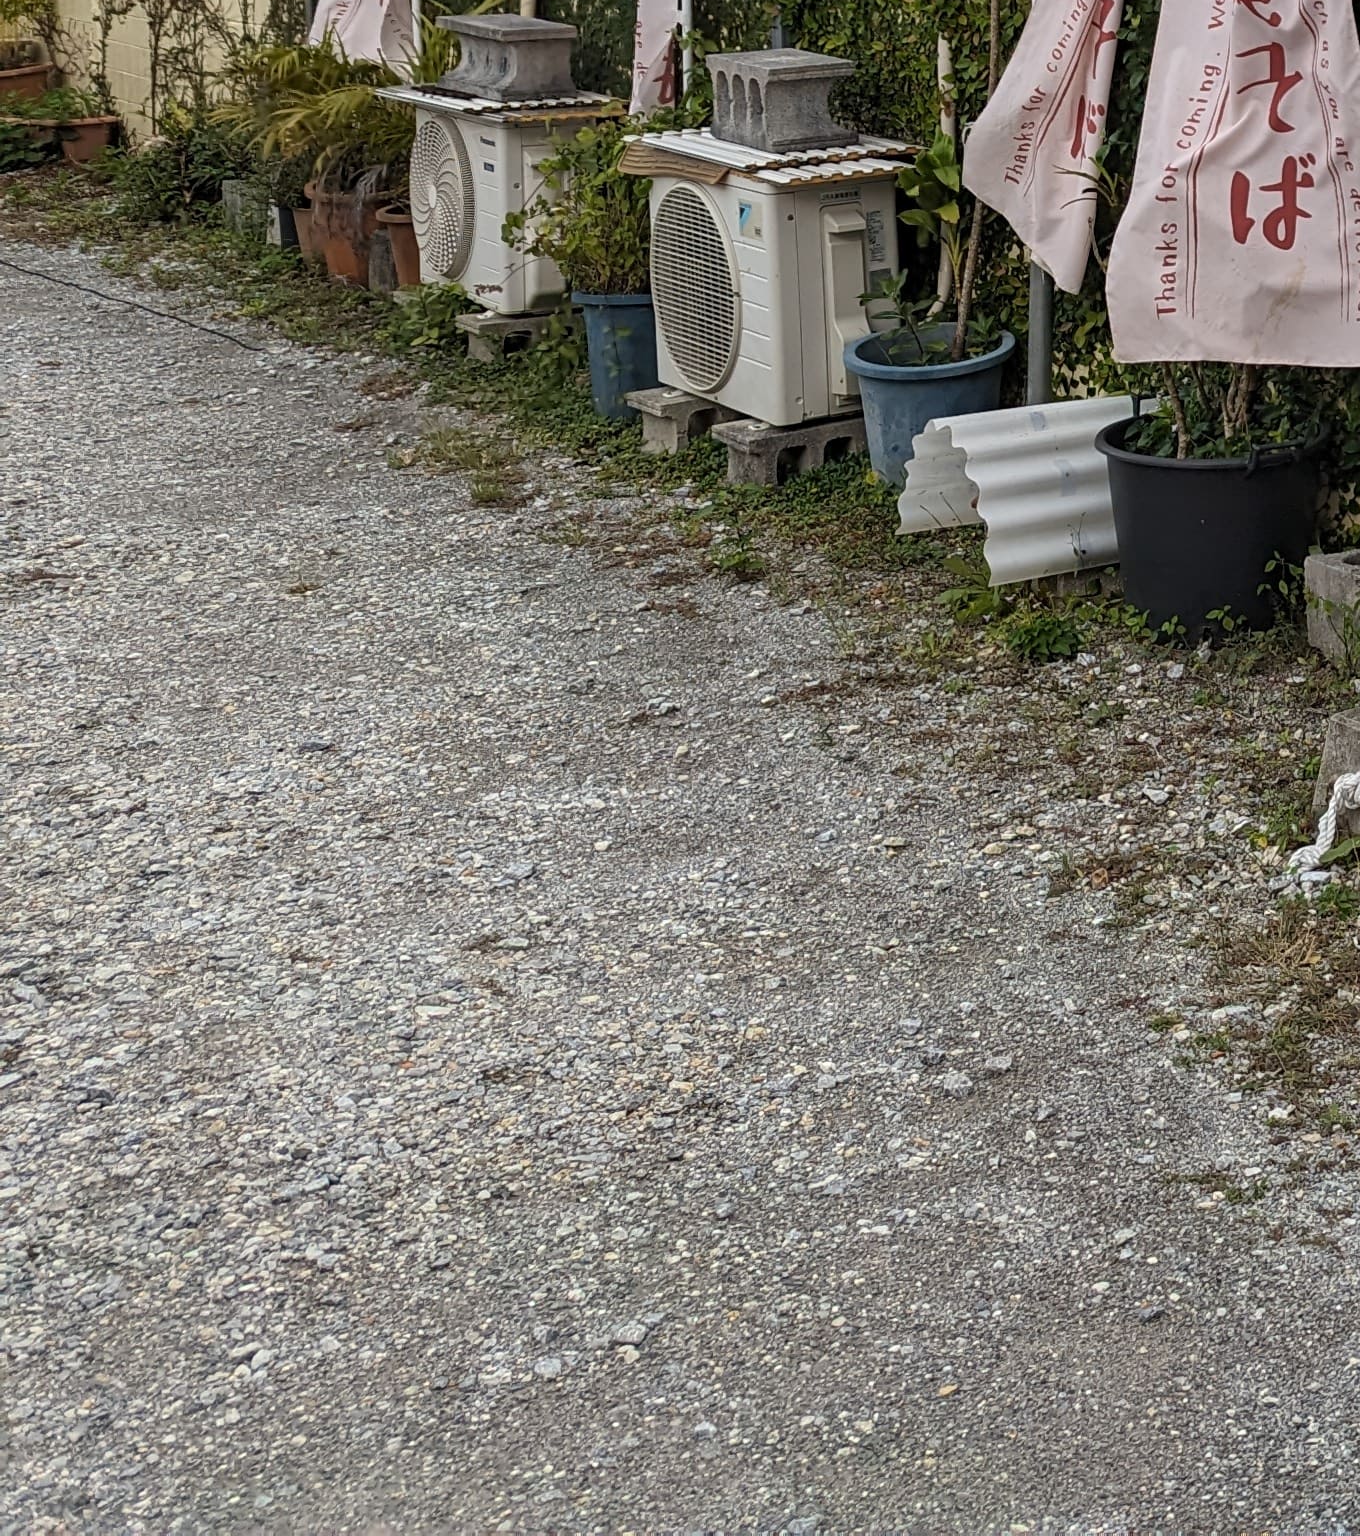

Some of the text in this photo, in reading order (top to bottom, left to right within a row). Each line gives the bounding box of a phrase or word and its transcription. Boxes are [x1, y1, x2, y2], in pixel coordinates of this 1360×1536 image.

[1004, 121, 1035, 184] Thanks
[1022, 86, 1047, 113] for
[1177, 52, 1223, 150] coming.
[1155, 164, 1180, 204] for
[1335, 136, 1355, 173] are
[1155, 222, 1178, 321] Thanks
